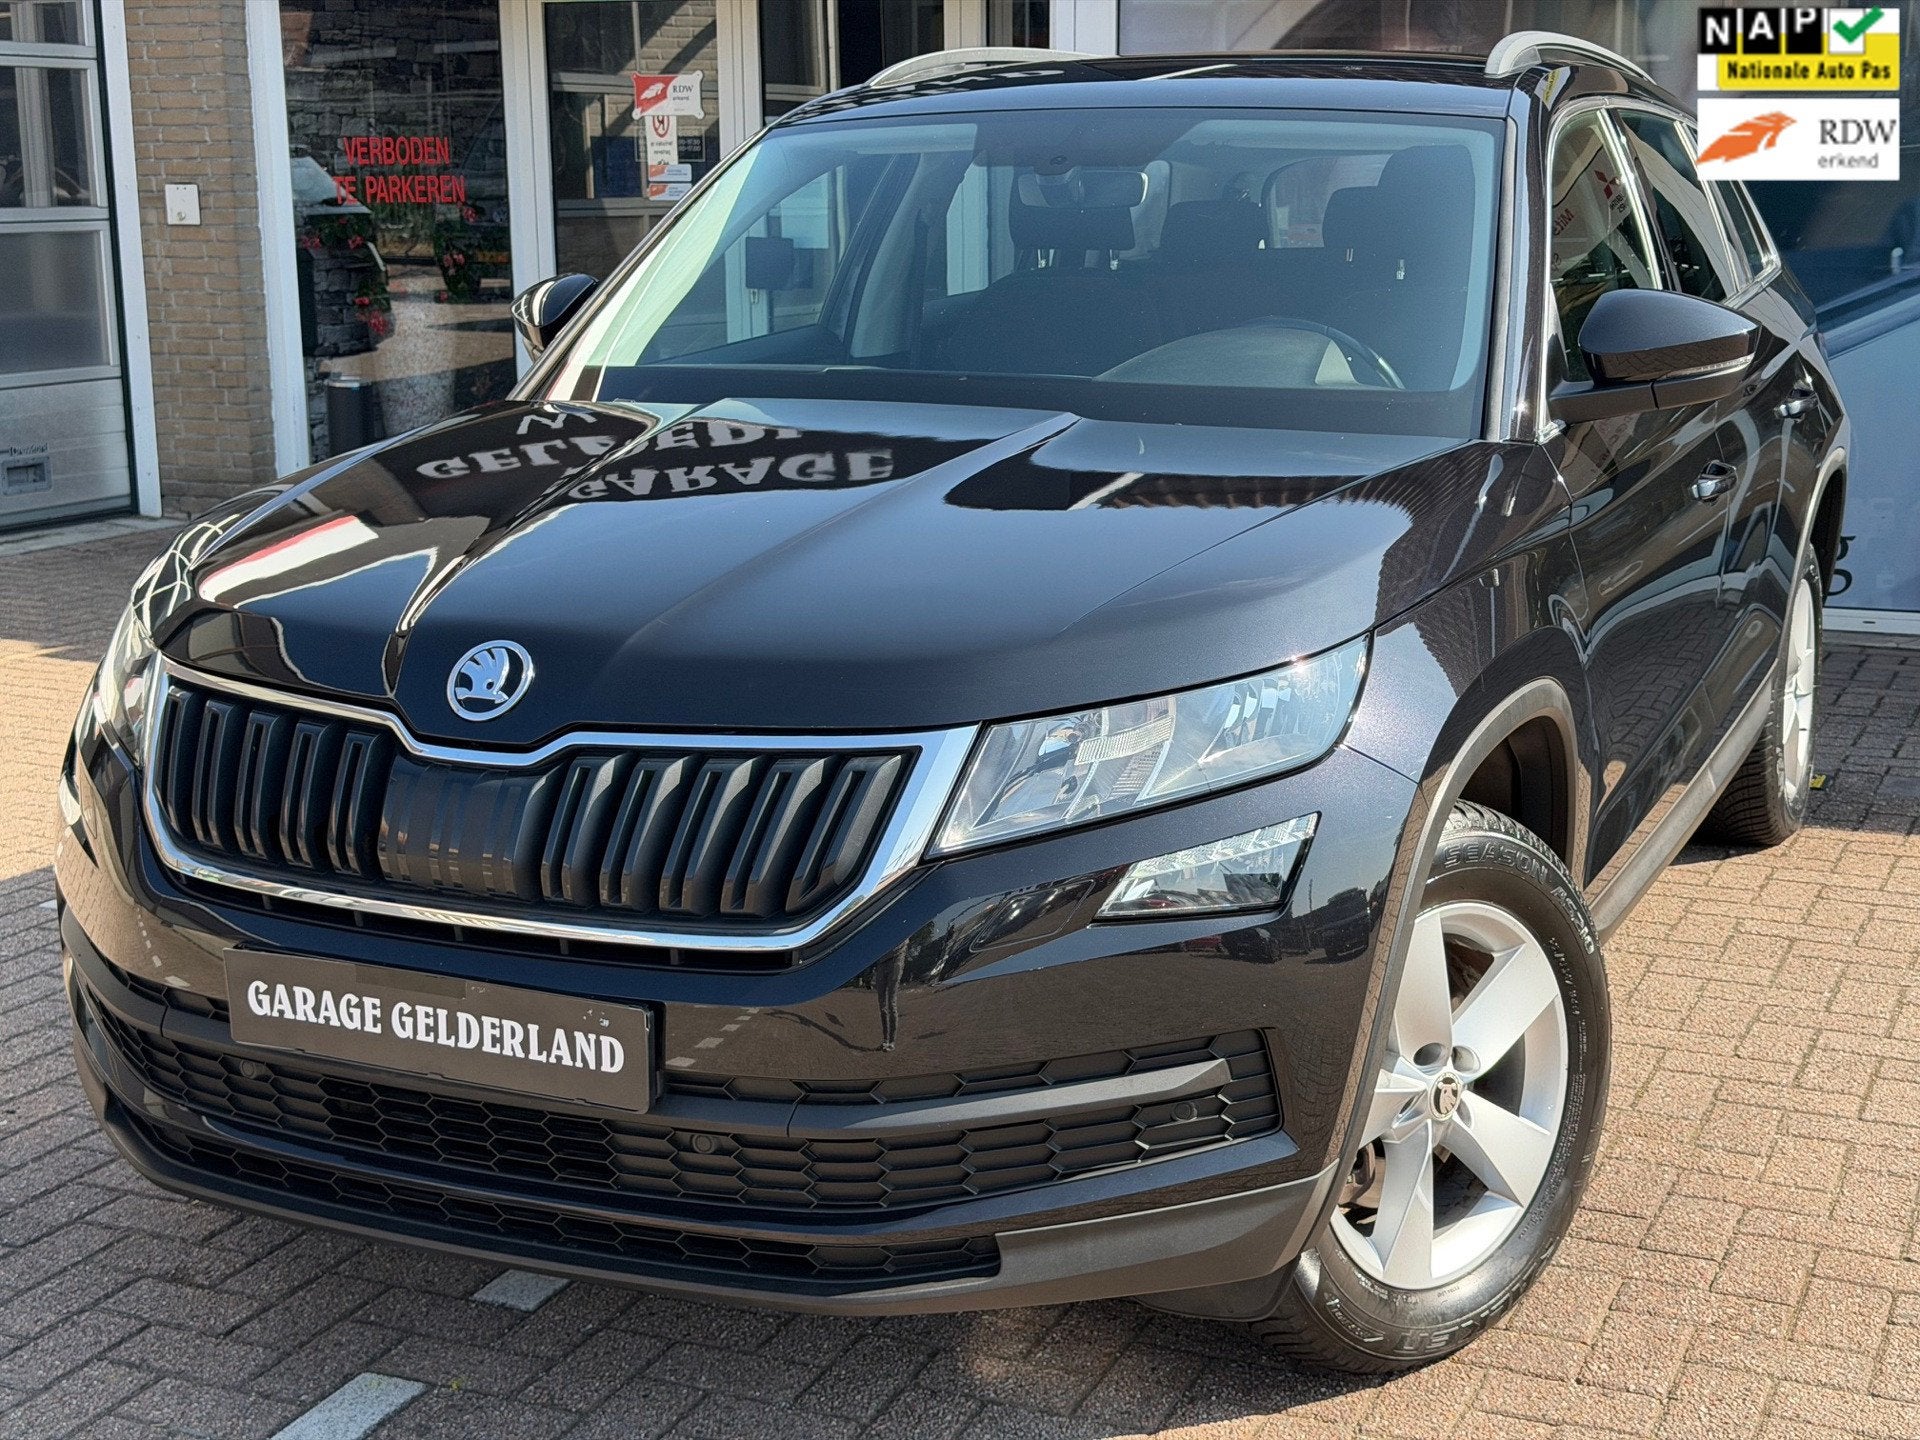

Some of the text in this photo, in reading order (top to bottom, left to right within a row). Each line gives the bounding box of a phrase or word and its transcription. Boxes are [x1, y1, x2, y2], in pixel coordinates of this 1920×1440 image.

[672, 85, 694, 93] RDW
[343, 136, 450, 165] VERBODEN
[333, 174, 466, 205] TE PARKEREN
[247, 980, 625, 1073] GARAGE GELDERLAND
